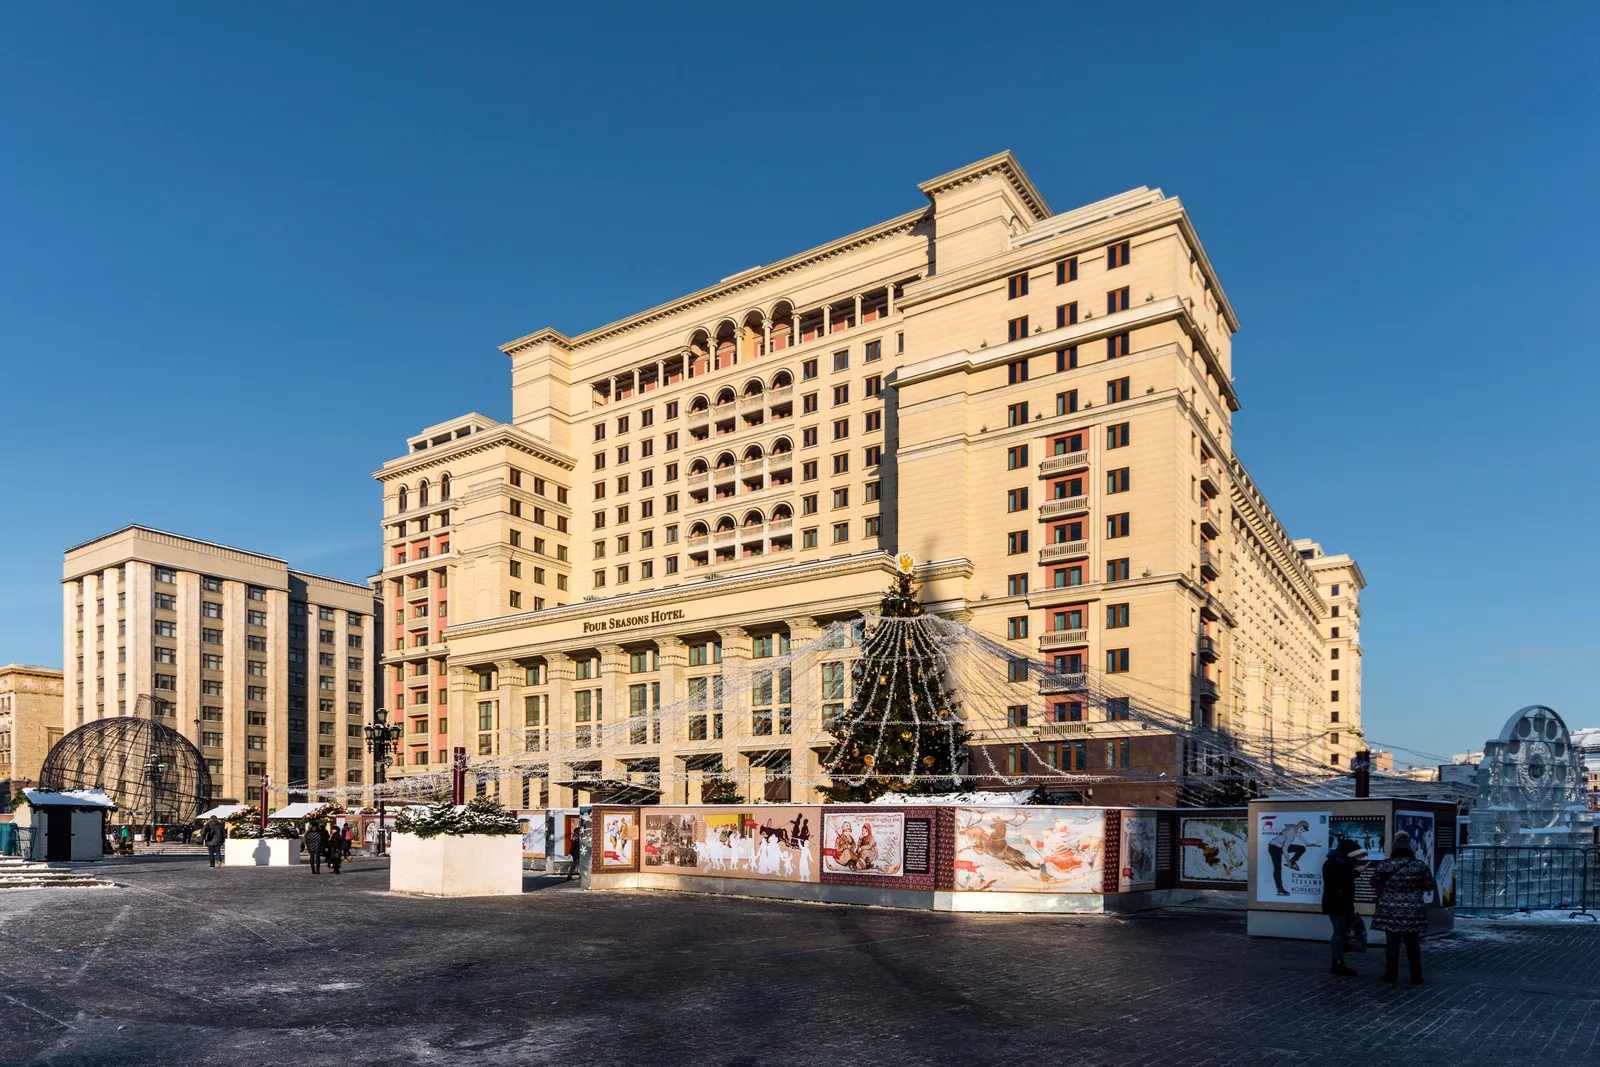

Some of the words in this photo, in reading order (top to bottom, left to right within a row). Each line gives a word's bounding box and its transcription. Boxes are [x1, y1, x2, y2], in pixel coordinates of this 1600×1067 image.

[583, 622, 607, 633] FOUR
[609, 616, 649, 630] SEASONS
[651, 610, 684, 623] HOTEL
